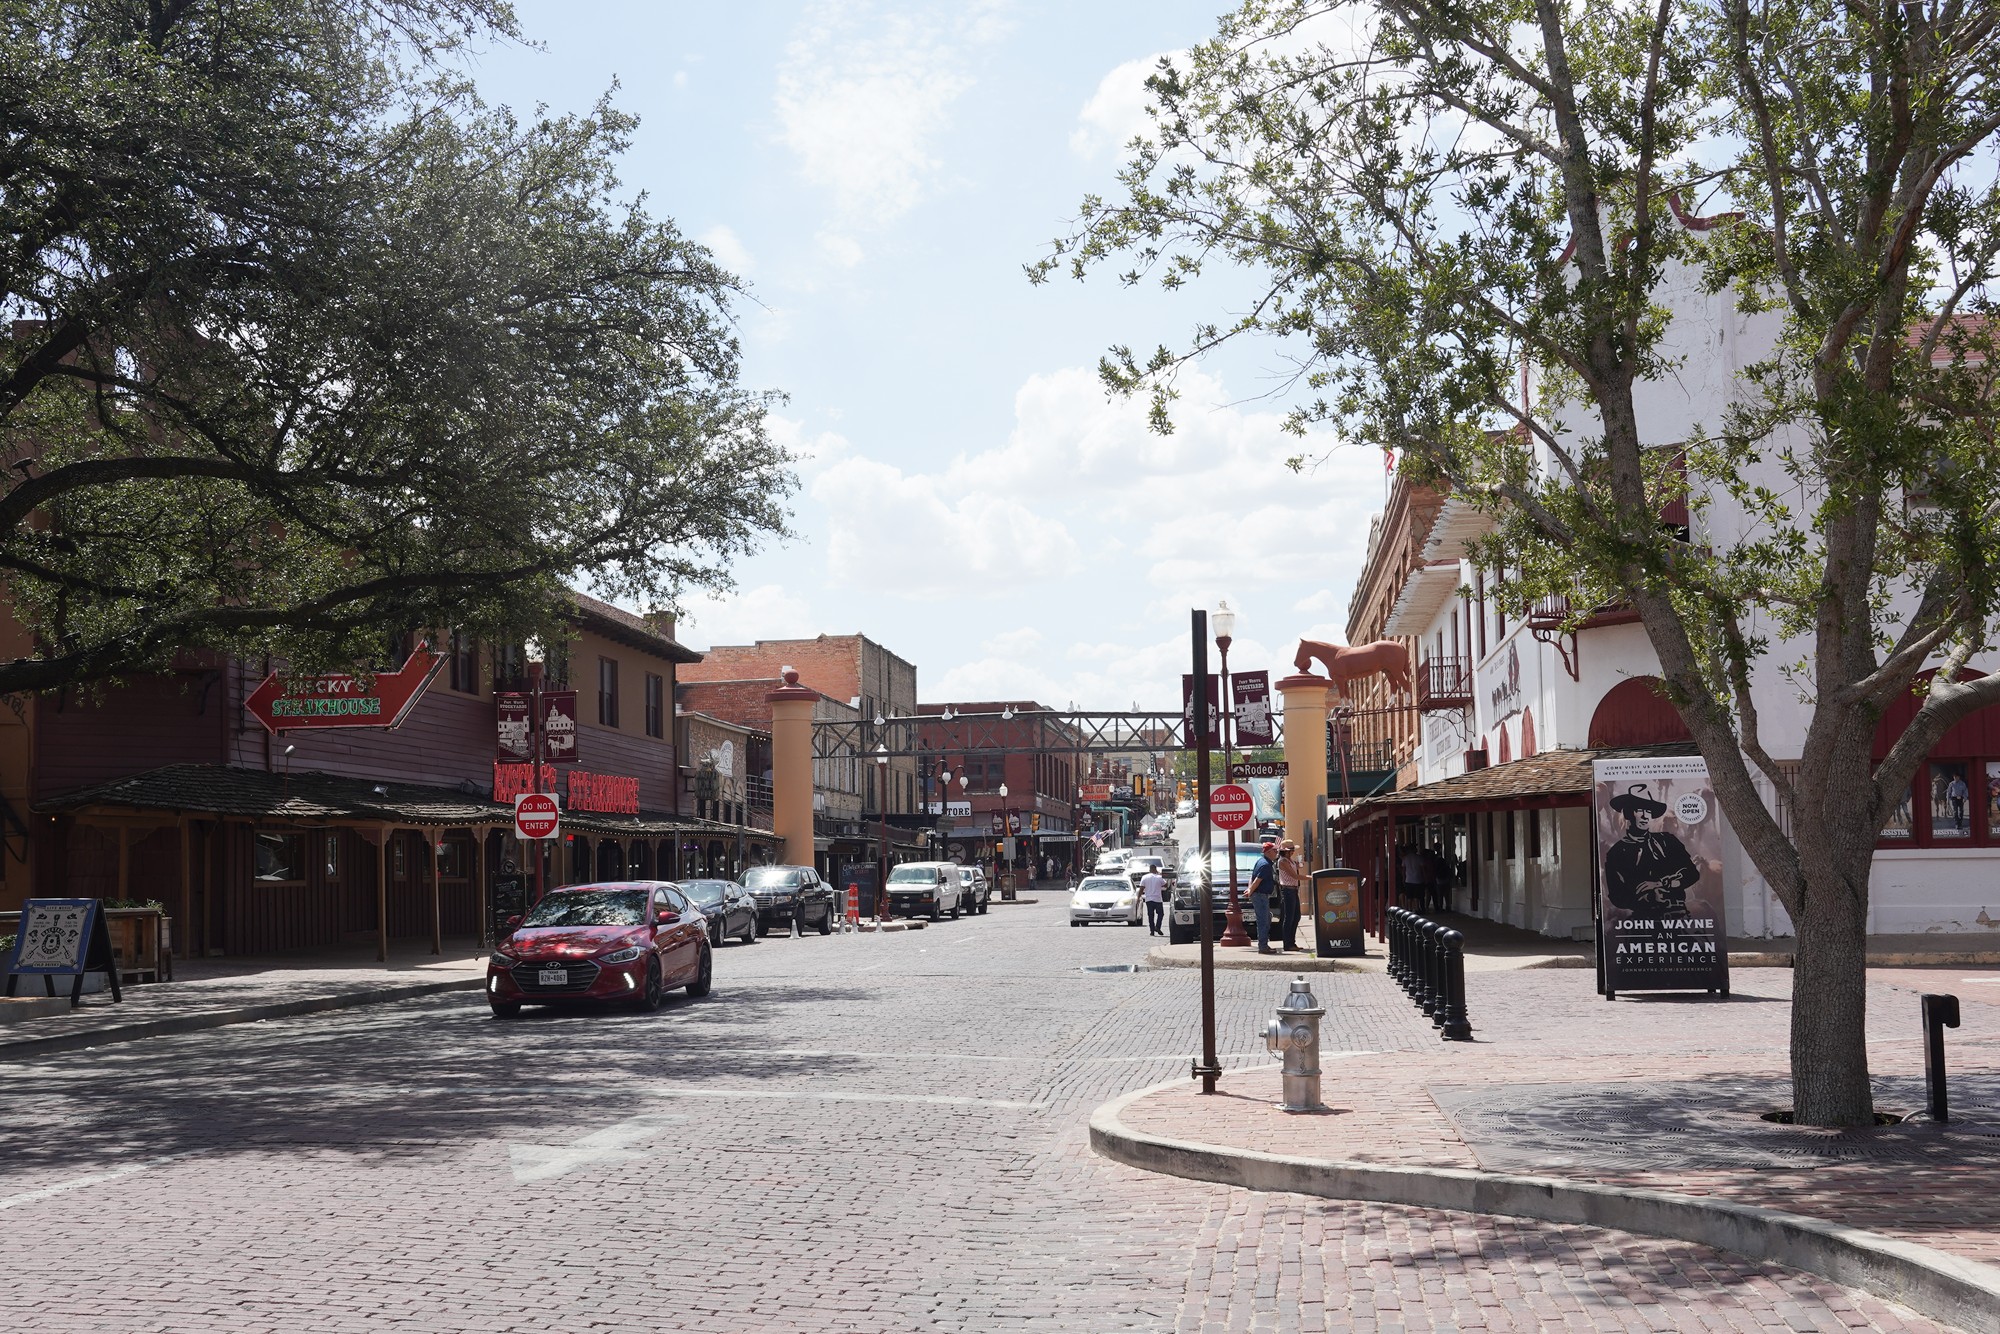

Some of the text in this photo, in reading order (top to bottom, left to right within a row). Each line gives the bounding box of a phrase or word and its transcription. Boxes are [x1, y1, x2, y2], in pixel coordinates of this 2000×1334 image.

[1236, 682, 1264, 691] STOCKYARDS
[272, 698, 380, 716] STEAKHOUSE
[1245, 764, 1272, 775] Rodeo
[568, 771, 640, 814] STEAKHOUSE
[942, 808, 970, 816] TORE
[1615, 919, 1714, 930] JOHN WAYNE
[1616, 942, 1716, 953] AMERICAN
[1616, 956, 1716, 964] EXPERIENCE
